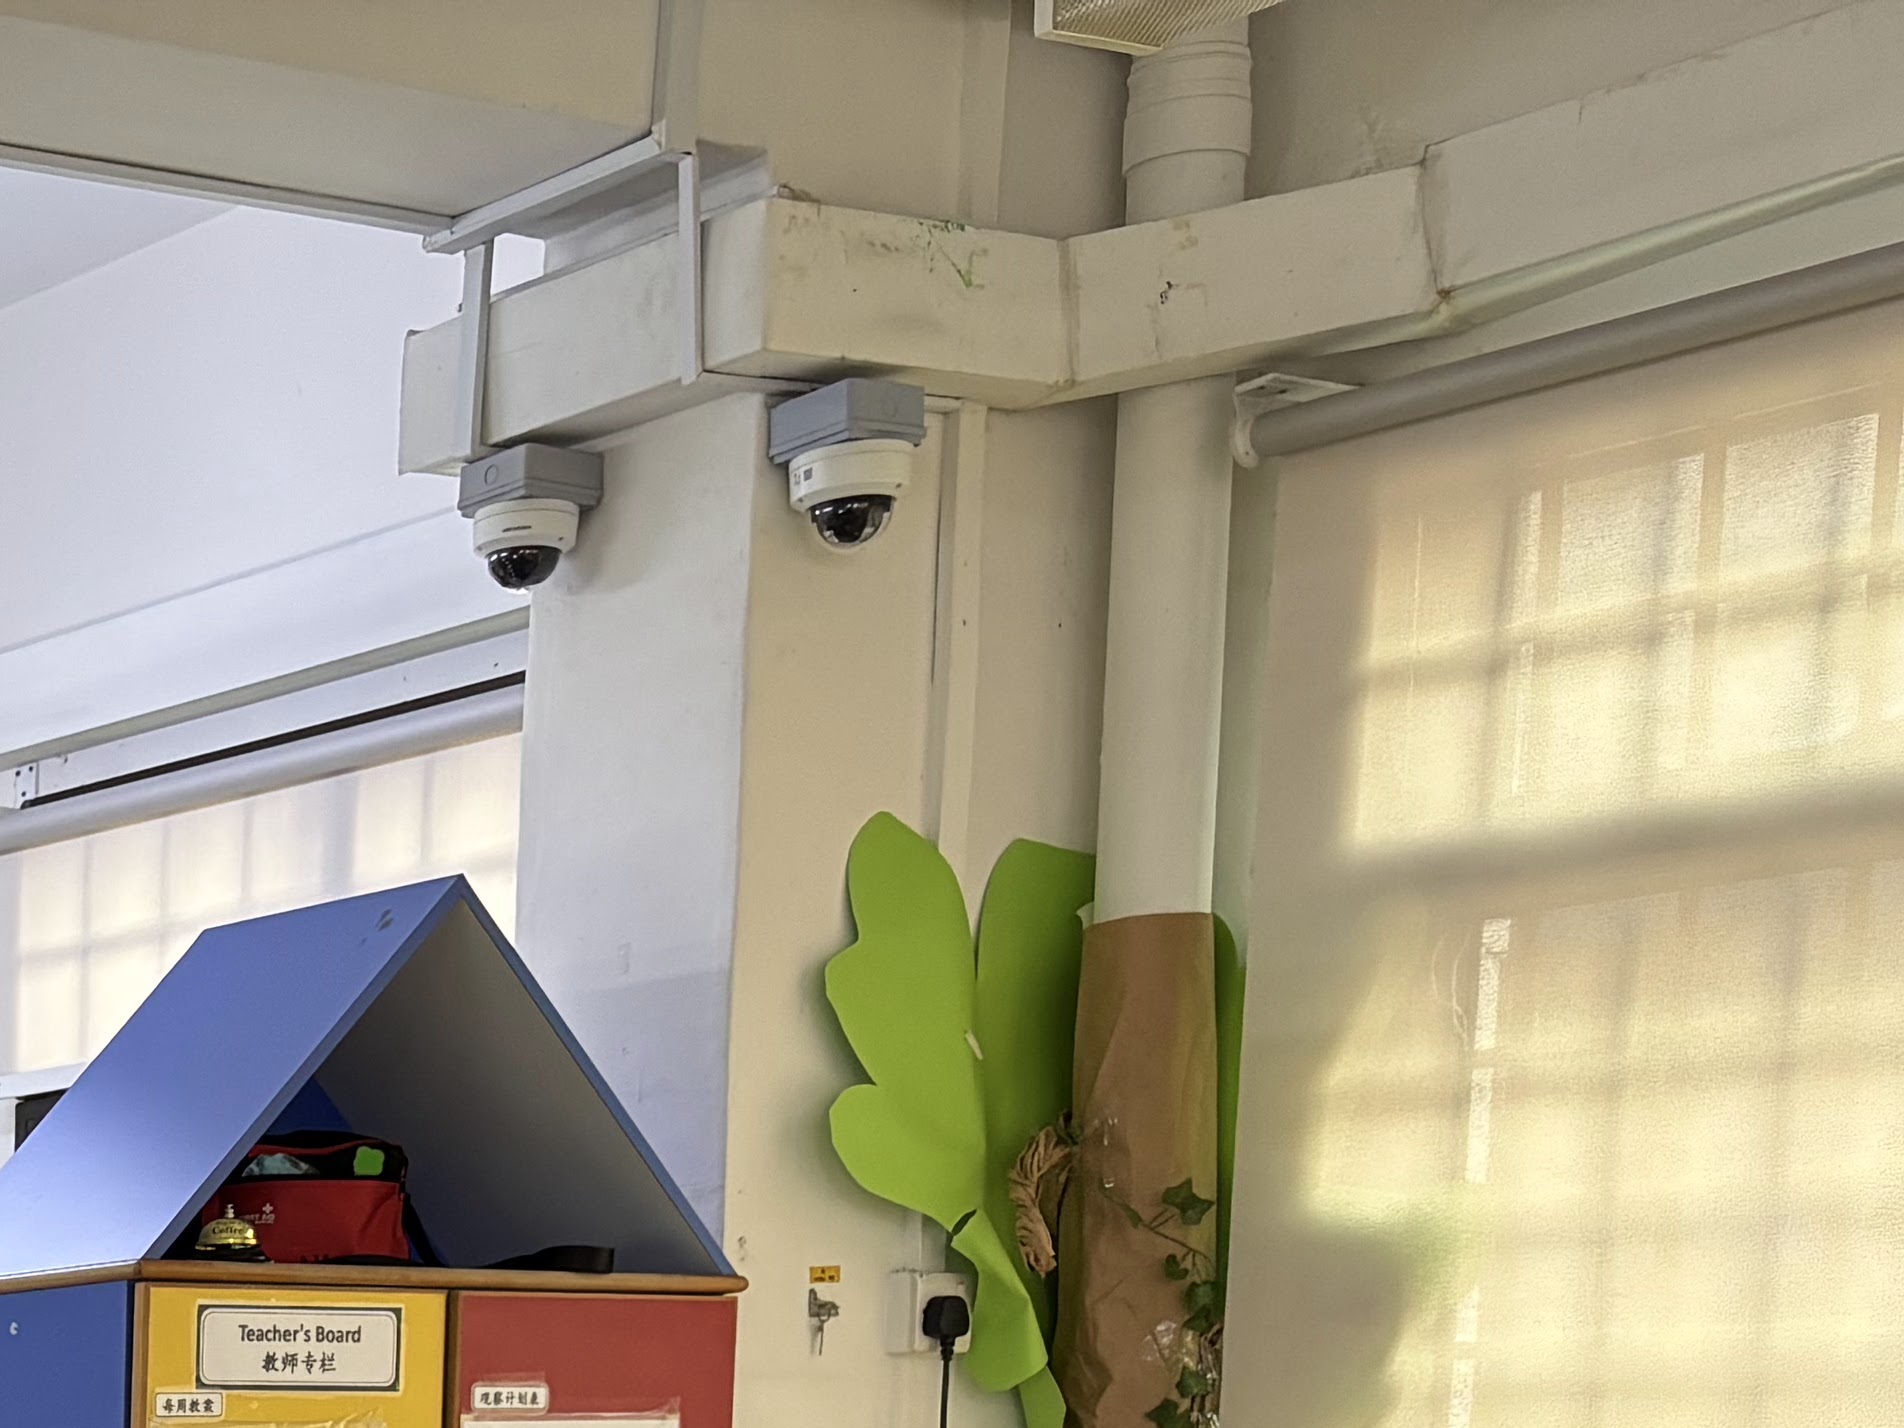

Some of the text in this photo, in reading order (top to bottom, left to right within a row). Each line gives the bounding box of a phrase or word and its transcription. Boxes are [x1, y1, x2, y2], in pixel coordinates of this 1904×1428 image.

[238, 1323, 362, 1344] Teacher's Board
[261, 1351, 337, 1374] 教师专栏
